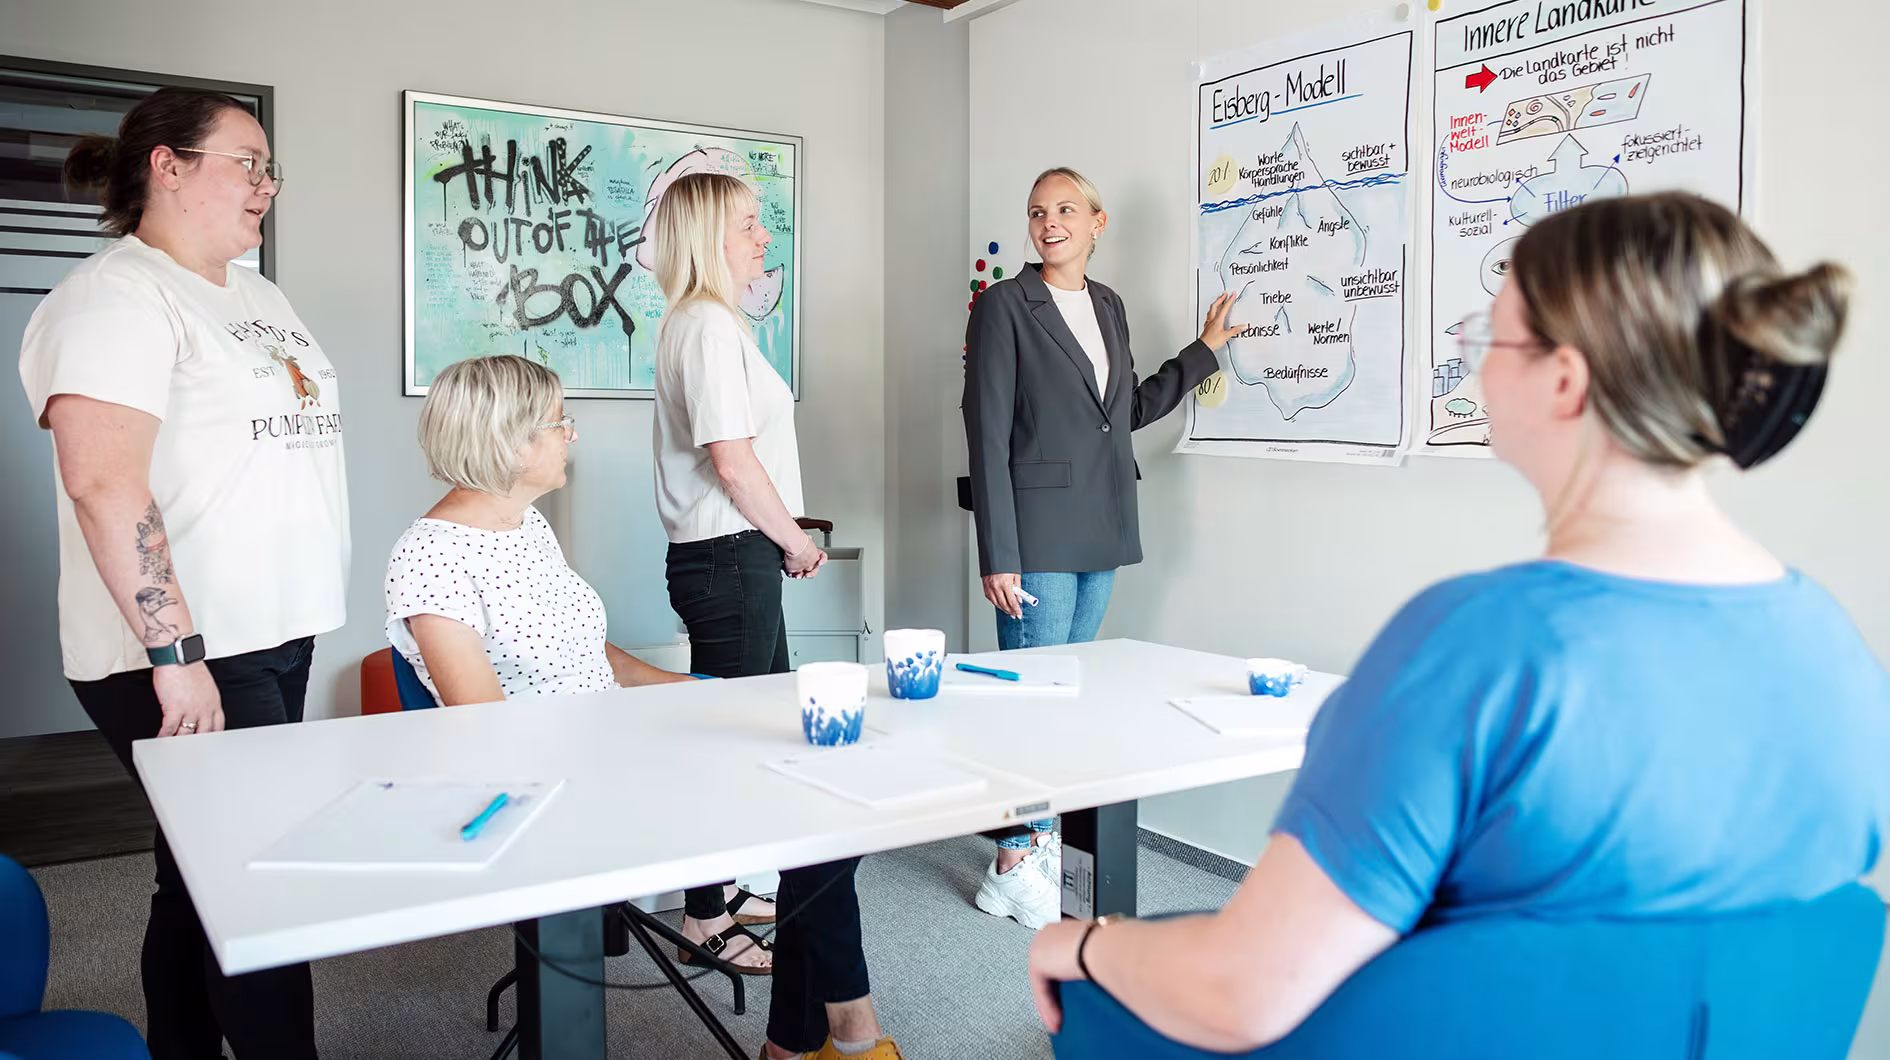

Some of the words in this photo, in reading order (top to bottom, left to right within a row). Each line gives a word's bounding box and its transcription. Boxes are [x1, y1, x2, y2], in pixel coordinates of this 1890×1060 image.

[1464, 11, 1530, 52] Innere
[1534, 0, 1656, 34] Landkar
[1498, 65, 1524, 80] Die
[1526, 43, 1599, 75] Landkarte
[1606, 34, 1628, 57] ist
[1635, 24, 1675, 50] nicht
[1538, 67, 1566, 85] das
[1572, 56, 1619, 77] Gebiet
[1212, 84, 1270, 123] Eisberg
[1285, 58, 1346, 107] Modell
[1450, 111, 1488, 130] Innen-
[1341, 144, 1385, 162] sichtbar
[1449, 136, 1489, 153] Modell
[1627, 134, 1702, 164] zielgerichtet
[1257, 151, 1284, 166] Worte
[1348, 154, 1391, 172] bewusst
[1238, 160, 1299, 184] Körpersprache
[1253, 170, 1305, 189] Handlungen
[1450, 164, 1538, 190] neurobiologisch
[1542, 189, 1588, 212] Filter
[1252, 206, 1283, 224] Gefühle
[1317, 215, 1350, 237] Ängste
[1459, 222, 1492, 239] sozial
[457, 216, 533, 264] OUT
[1269, 234, 1310, 254] Konflikte
[1229, 257, 1290, 276] Persönlichkeit
[1340, 267, 1398, 287] unsichtbar
[496, 262, 635, 337] BOX
[1259, 289, 1293, 305] Triebe
[1343, 281, 1401, 299] unbewusst
[1230, 322, 1281, 339] ebnisse
[1307, 318, 1342, 334] Werte/
[1313, 332, 1351, 345] Normen
[1263, 362, 1329, 384] Bedürfnisse
